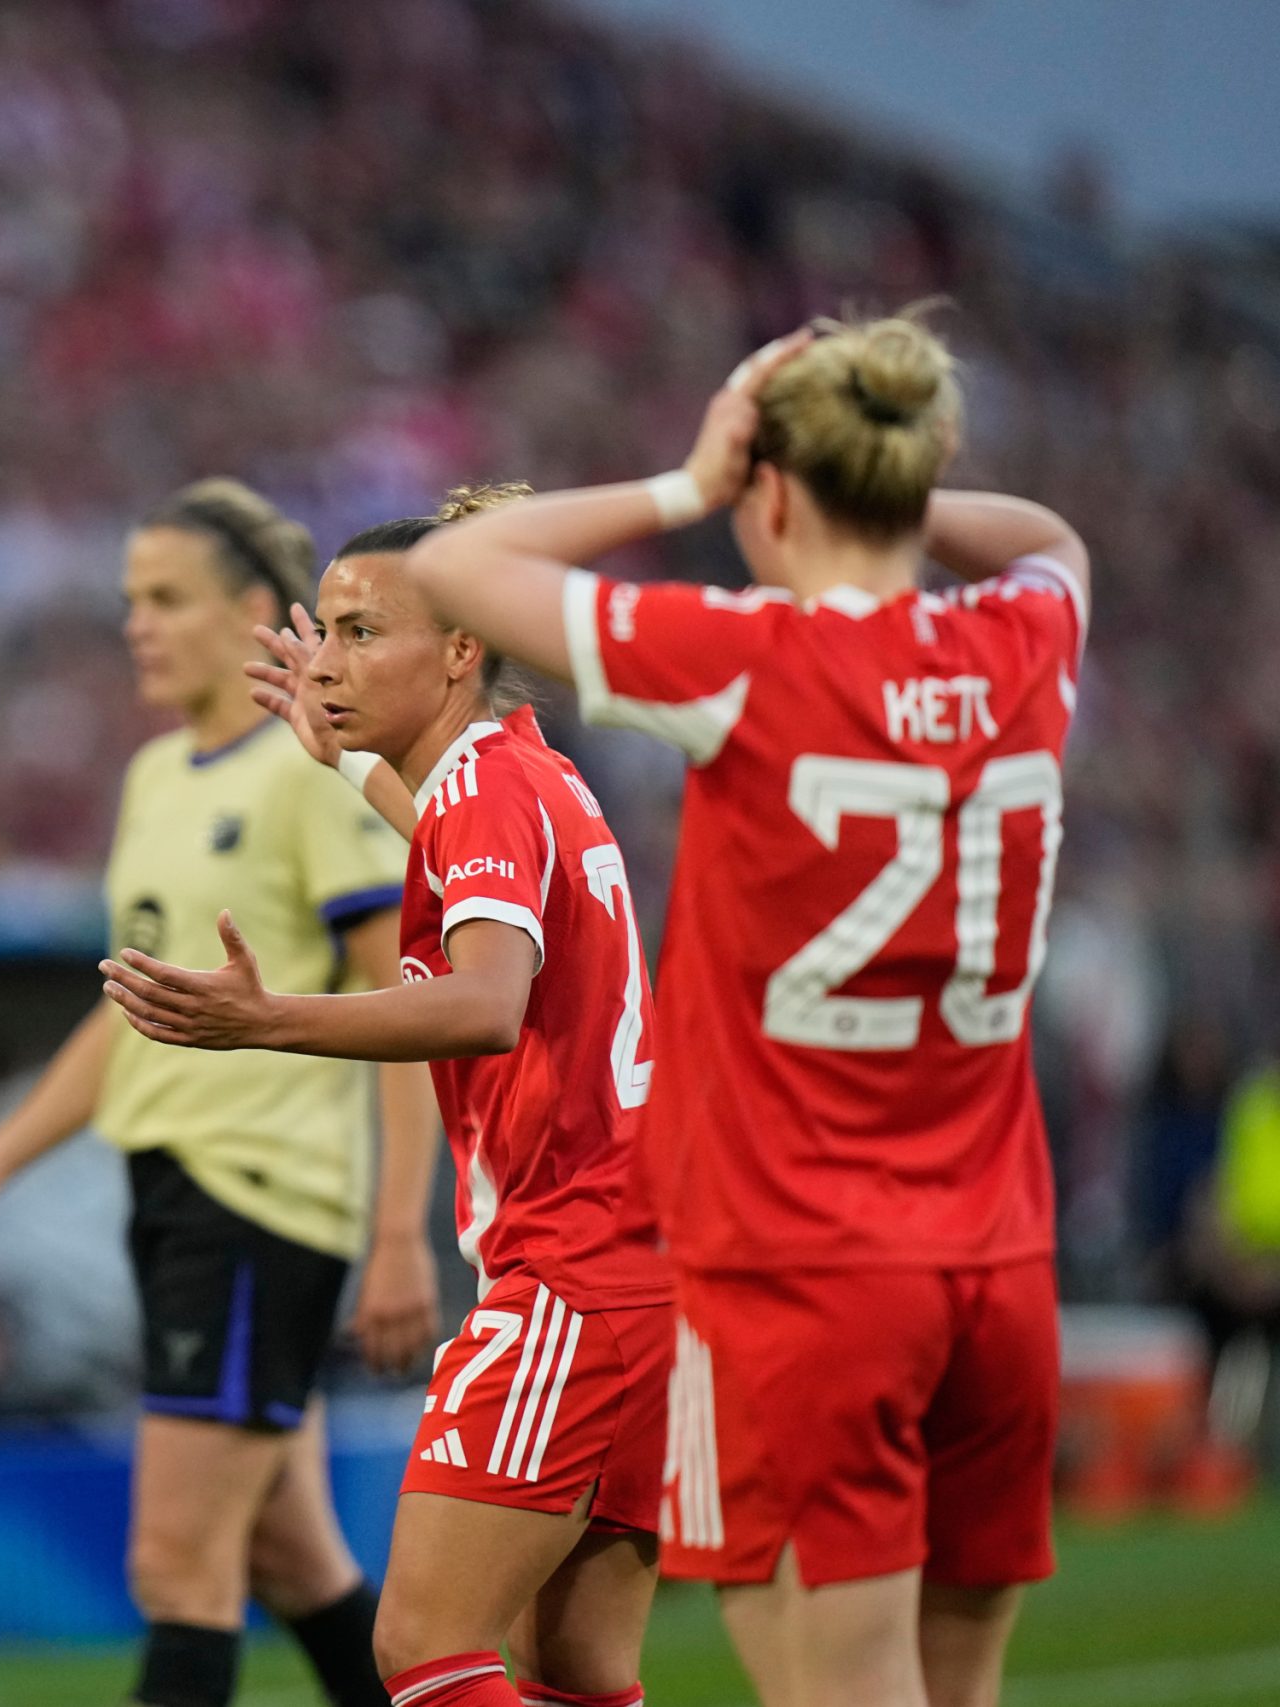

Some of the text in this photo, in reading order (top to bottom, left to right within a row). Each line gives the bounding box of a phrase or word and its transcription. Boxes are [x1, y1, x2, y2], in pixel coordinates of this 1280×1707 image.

[444, 856, 515, 887] ACHI
[762, 750, 1063, 1051] 20
[423, 1309, 524, 1414] 7
